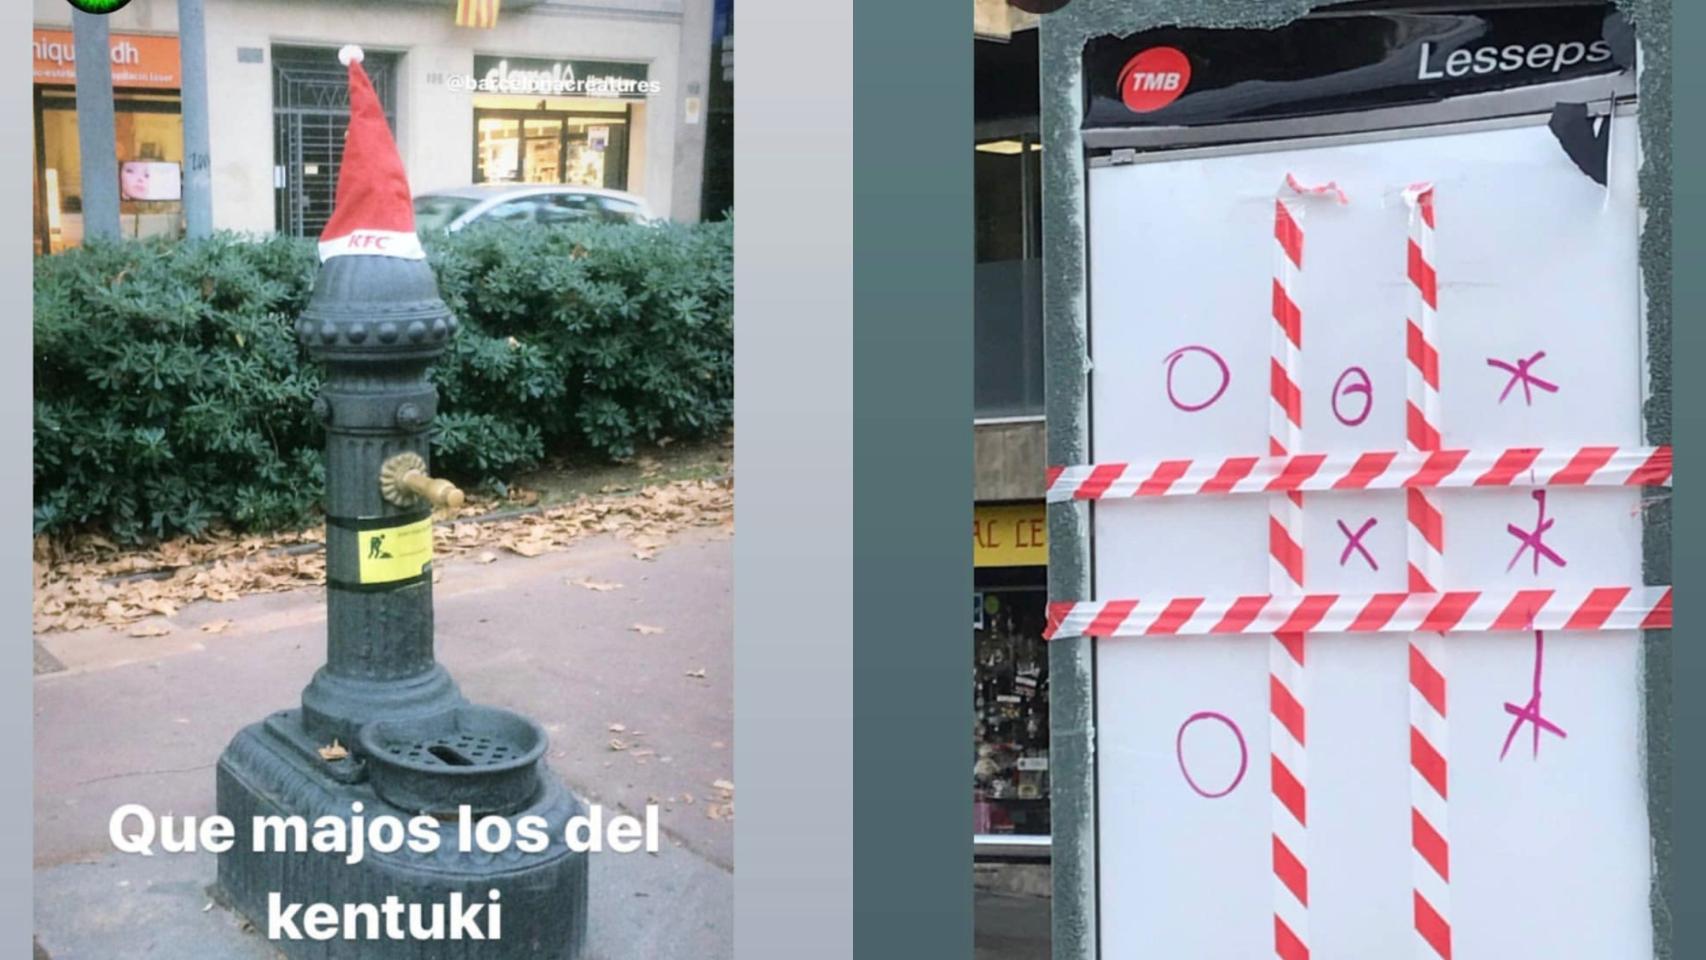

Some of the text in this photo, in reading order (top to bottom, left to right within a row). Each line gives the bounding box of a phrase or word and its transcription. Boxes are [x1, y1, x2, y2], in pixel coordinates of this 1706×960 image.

[111, 42, 139, 64] dh
[1418, 40, 1612, 80] Lesseps
[1133, 73, 1180, 91] TMB
[347, 234, 391, 249] KFC
